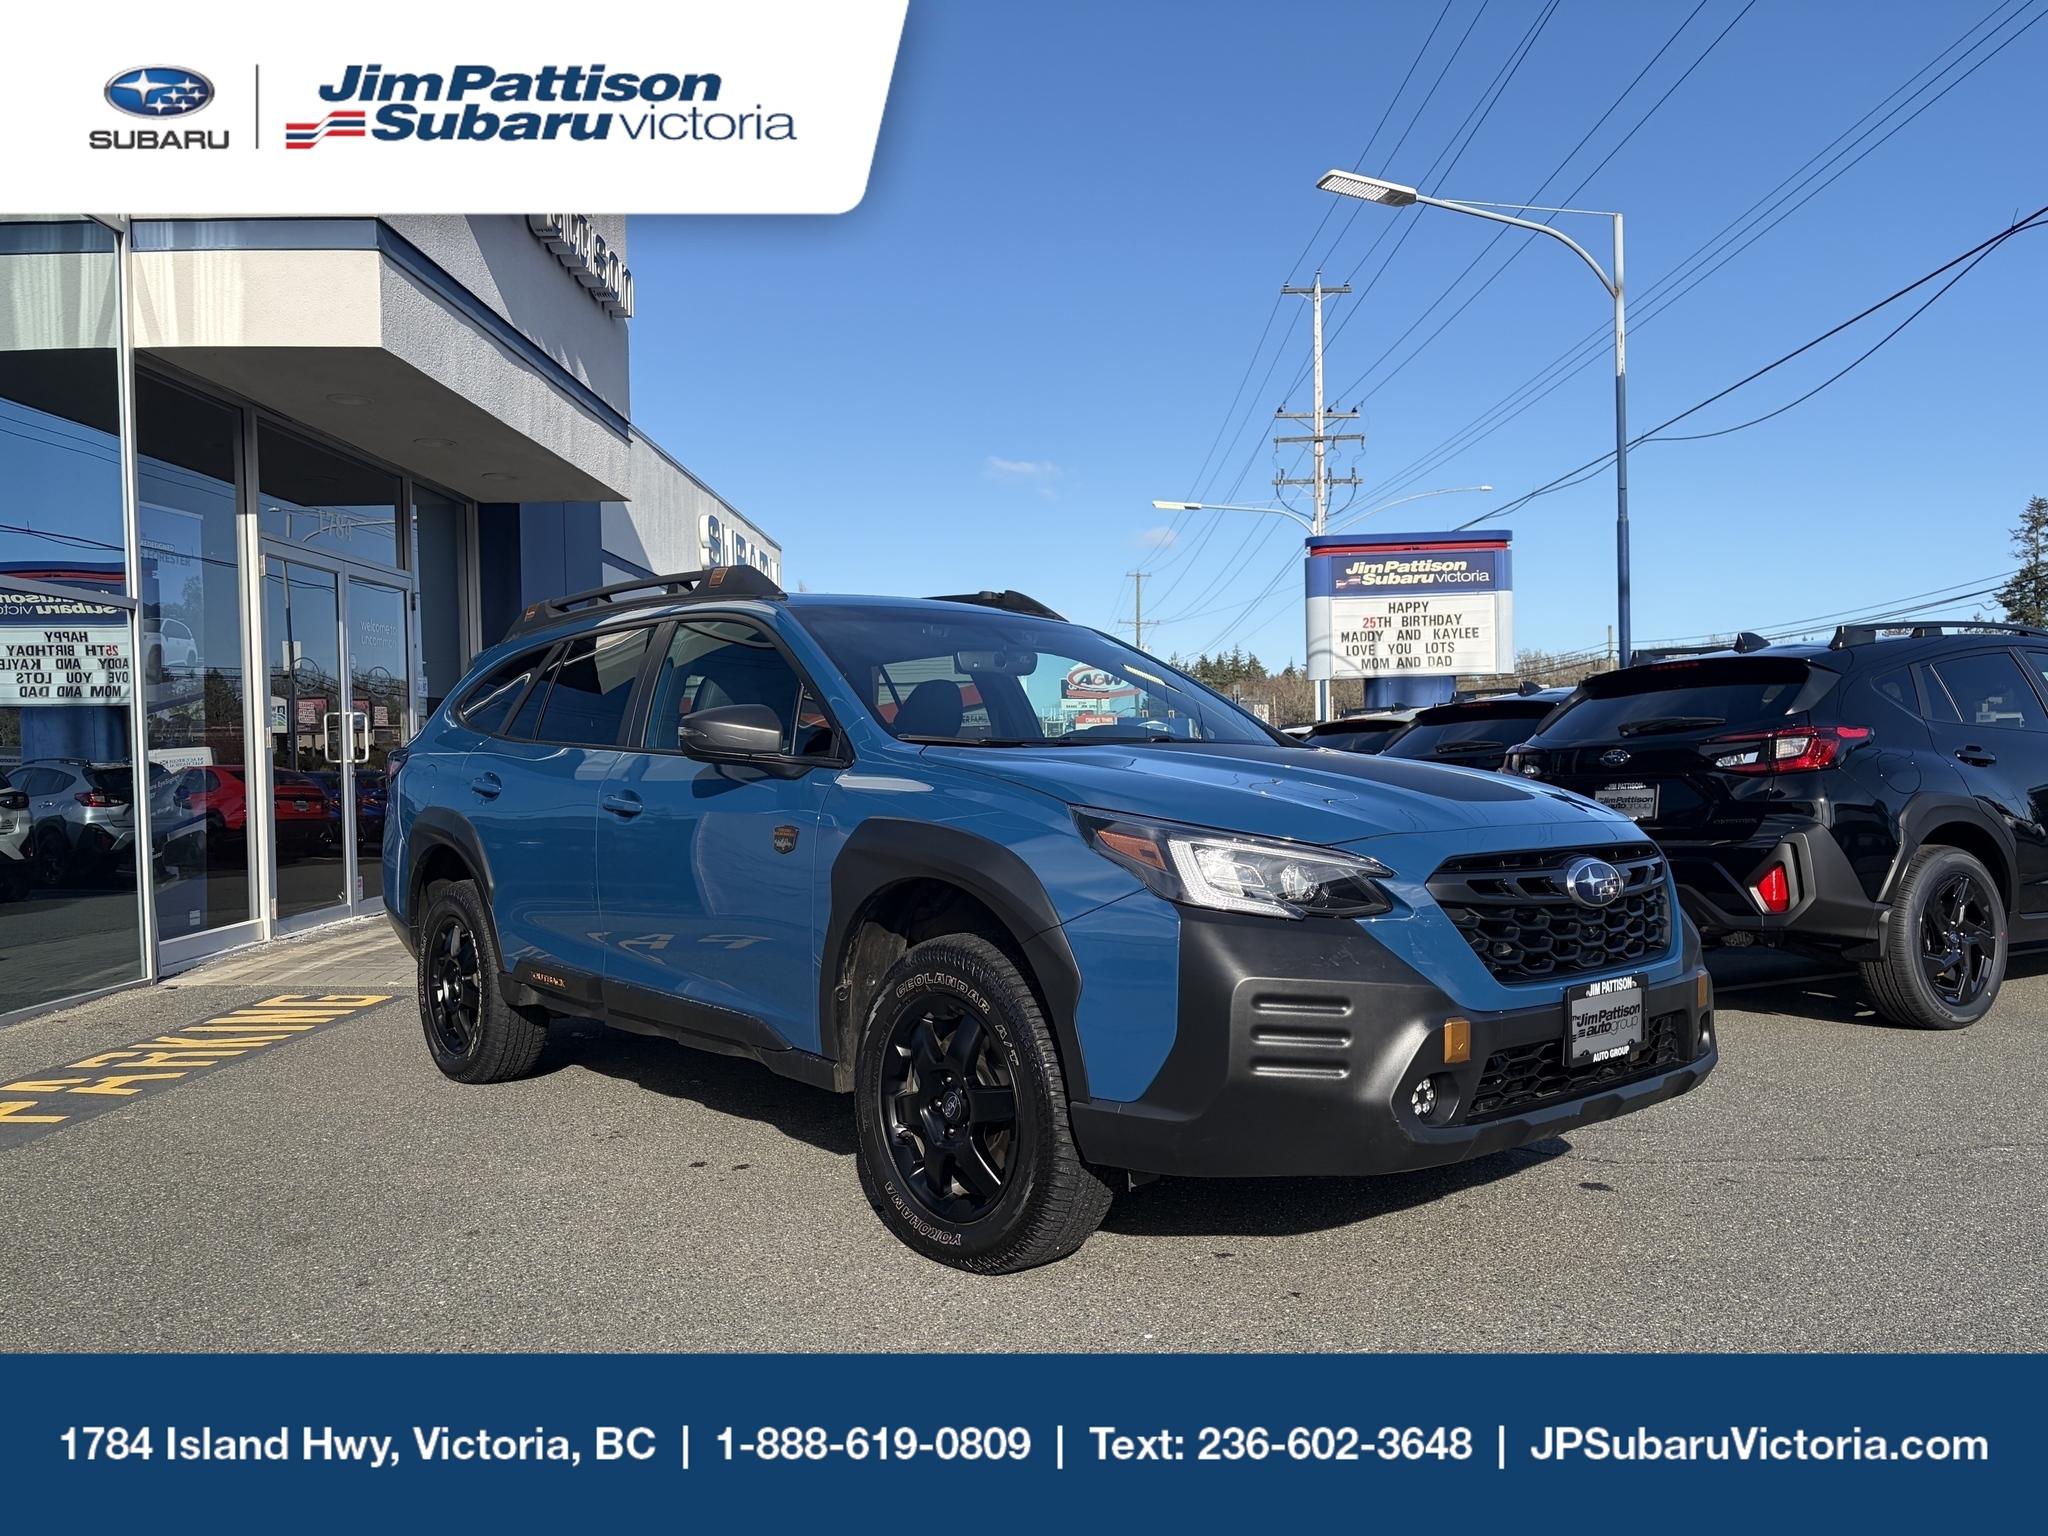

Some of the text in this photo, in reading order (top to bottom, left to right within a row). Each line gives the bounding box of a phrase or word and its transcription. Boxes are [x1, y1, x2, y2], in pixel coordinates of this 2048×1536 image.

[1346, 559, 1467, 575] Jim Pattison
[1362, 570, 1490, 586] Subaru victoria
[1388, 601, 1430, 614] HAPPY
[360, 618, 389, 634] welcome
[1362, 614, 1462, 629] 25TH BIRTHDAY
[361, 635, 397, 649] uncommon
[1341, 627, 1480, 643] MADDY AND KAYLEE
[1346, 642, 1455, 656] LOVE YOU LOTS
[1361, 655, 1452, 670] MOM AND DAD
[1078, 673, 1122, 686] A&W
[896, 972, 991, 1015] GEOLANDAR
[1589, 976, 1633, 997] JIM PATTISON
[1593, 1045, 1630, 1063] AUTO GROUP
[884, 1180, 962, 1246] YOKOHAMA
